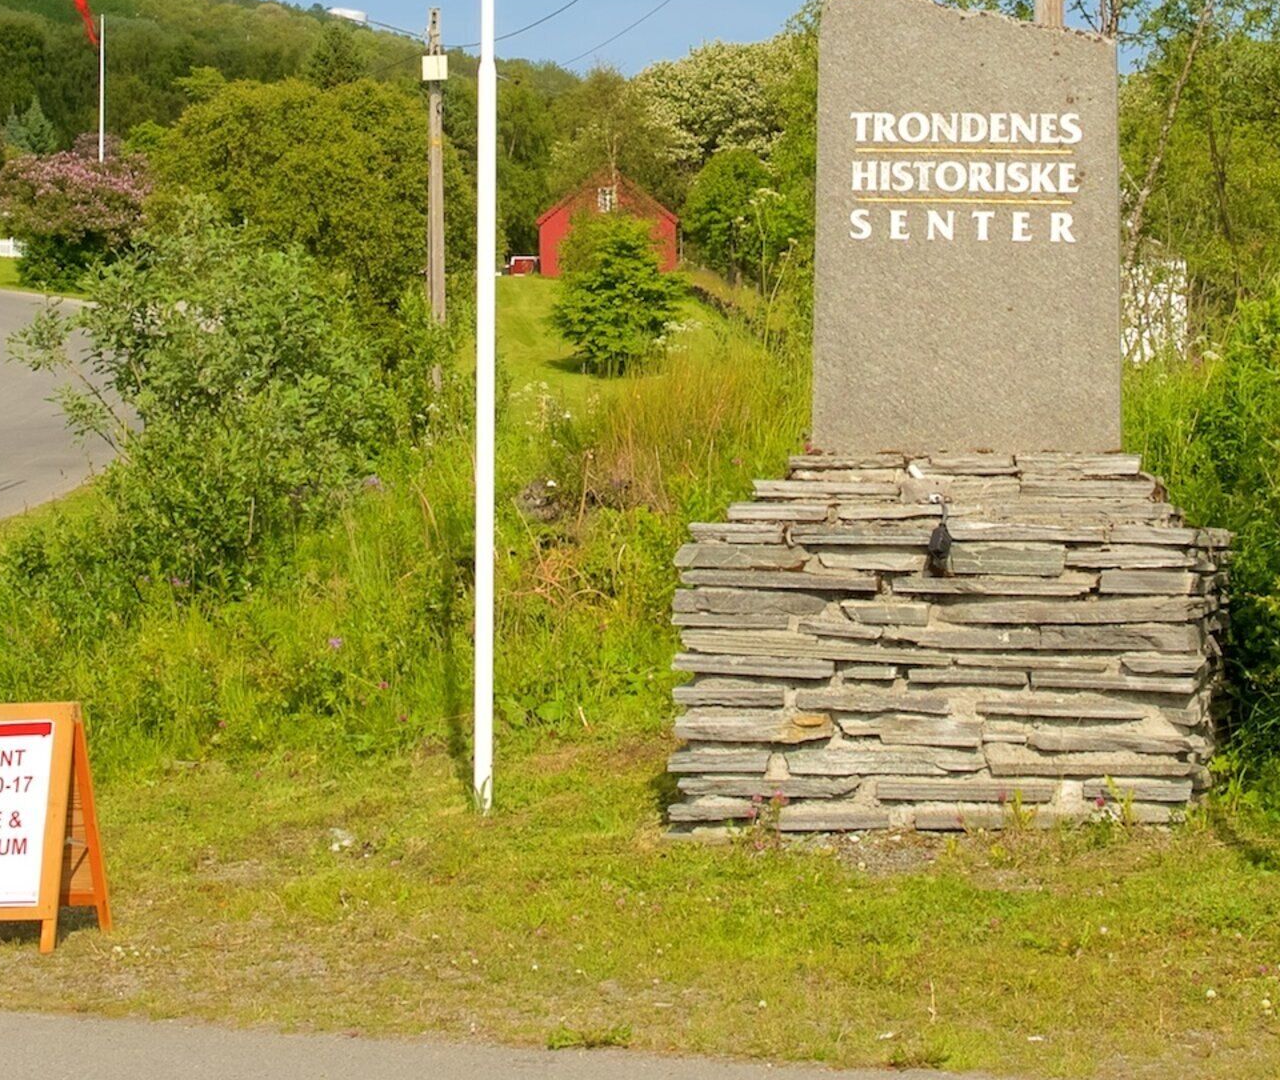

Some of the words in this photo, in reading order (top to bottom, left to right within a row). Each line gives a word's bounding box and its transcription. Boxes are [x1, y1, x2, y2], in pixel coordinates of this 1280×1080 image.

[850, 112, 1083, 144] TRONDENES
[851, 160, 1081, 194] HISTORISKE
[850, 208, 1077, 244] SENTER
[8, 810, 23, 829] &
